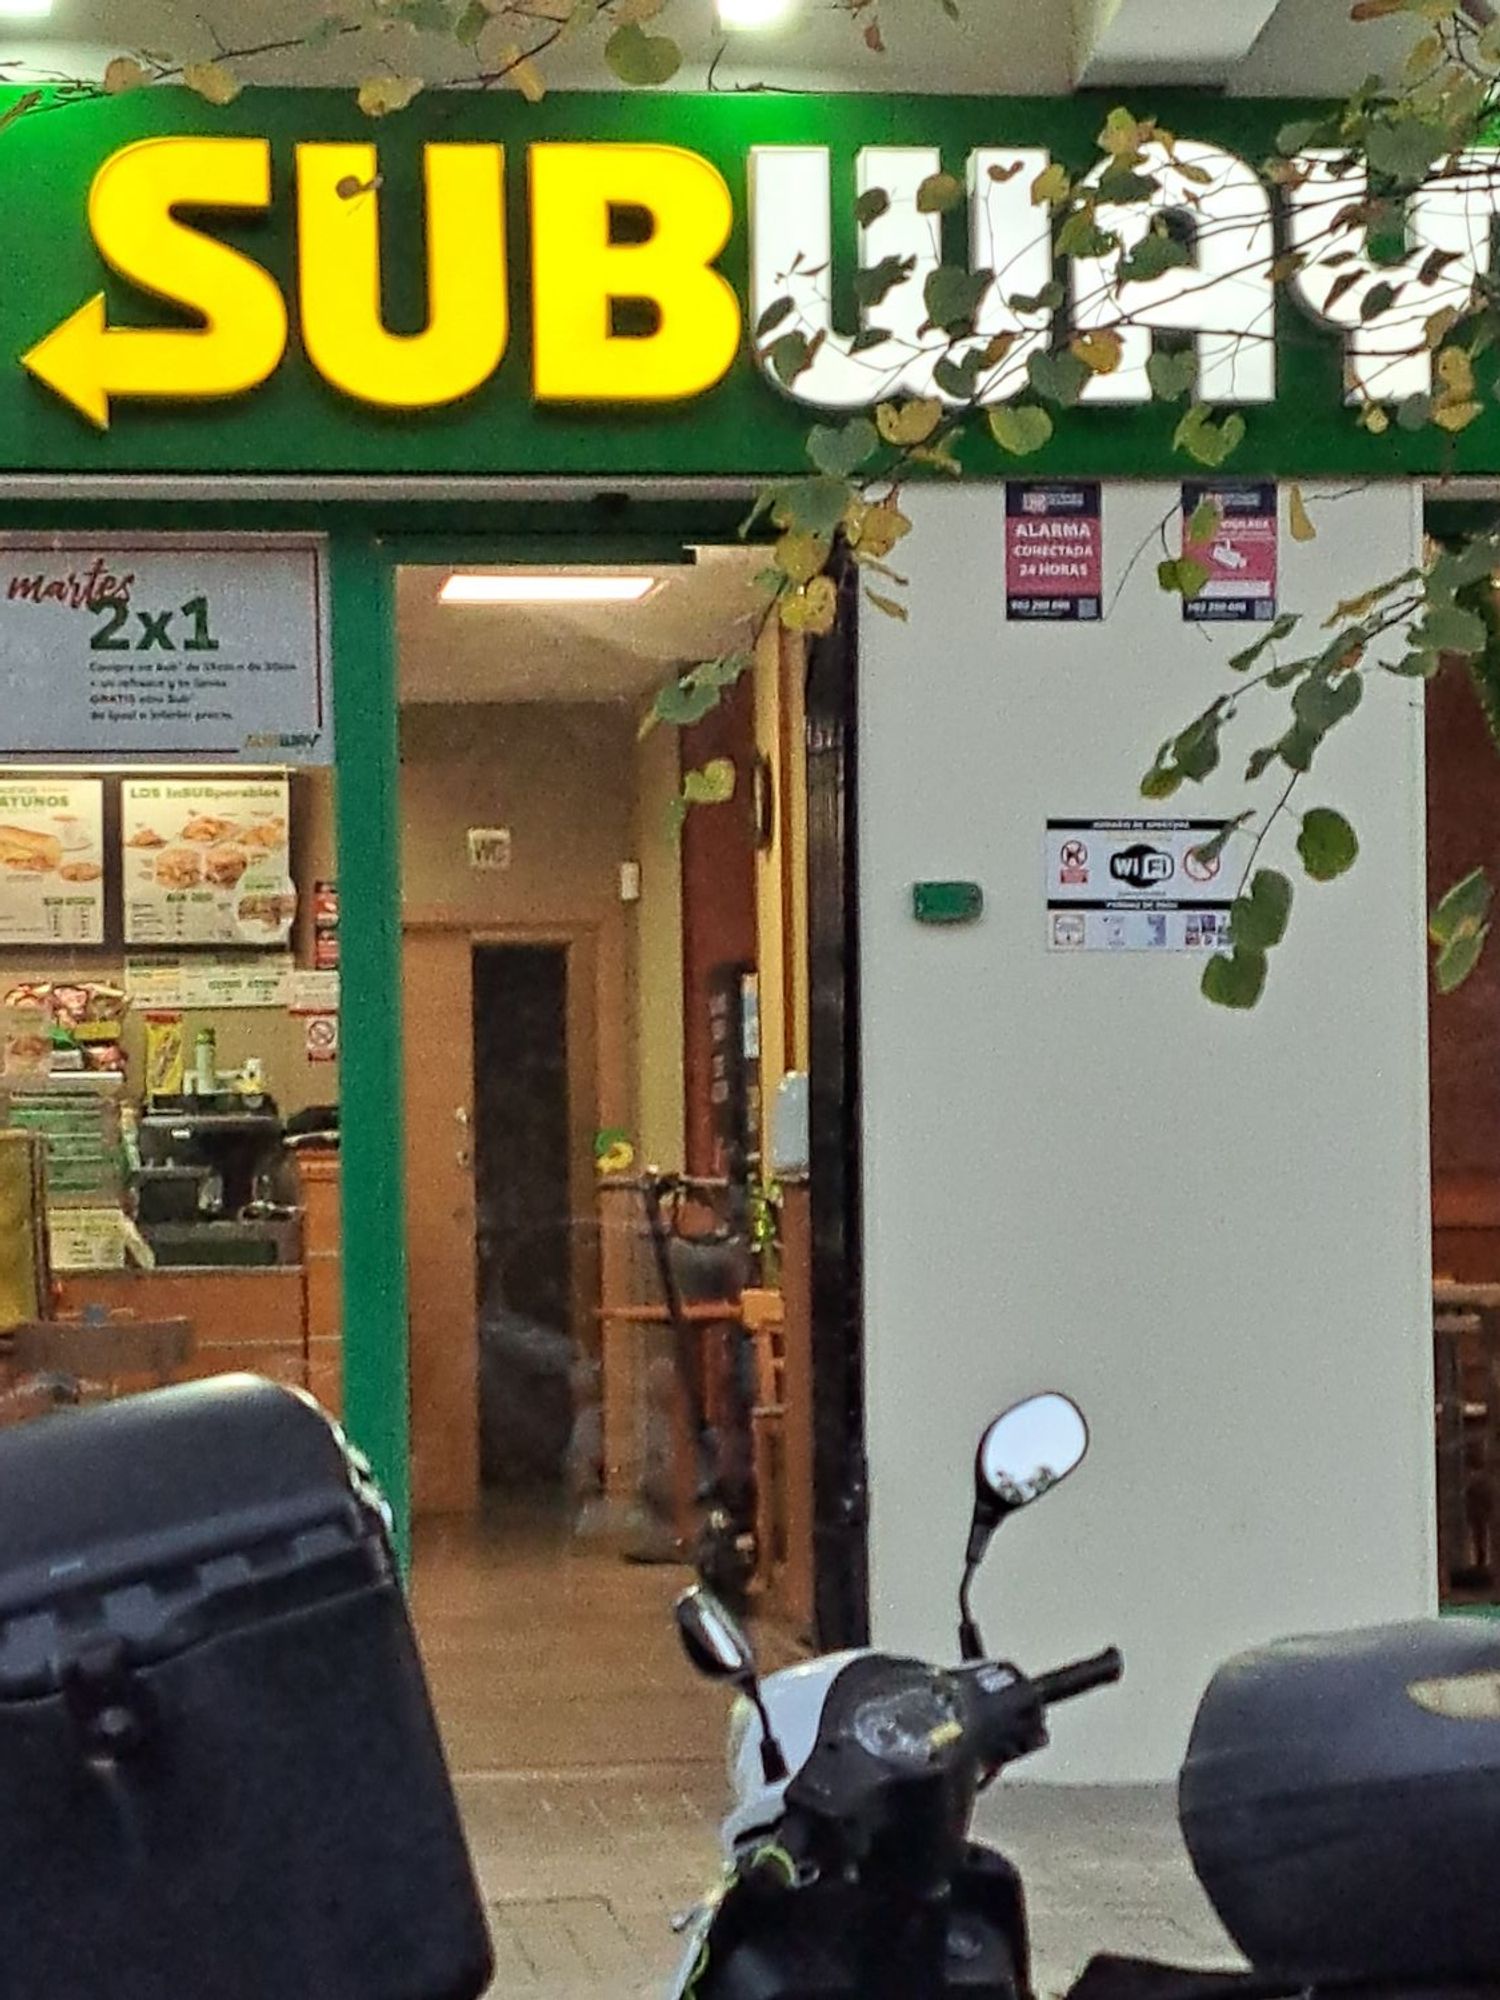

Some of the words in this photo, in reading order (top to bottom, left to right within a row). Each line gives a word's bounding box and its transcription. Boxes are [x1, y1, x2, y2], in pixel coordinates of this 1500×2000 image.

[22, 135, 1500, 430] SUBWAY
[1015, 522, 1091, 537] ALARMA
[1014, 545, 1093, 557] CONECTADA
[8, 558, 135, 609] martes
[1019, 563, 1037, 576] 24
[1039, 562, 1088, 577] HORAS
[90, 595, 219, 650] 2x1
